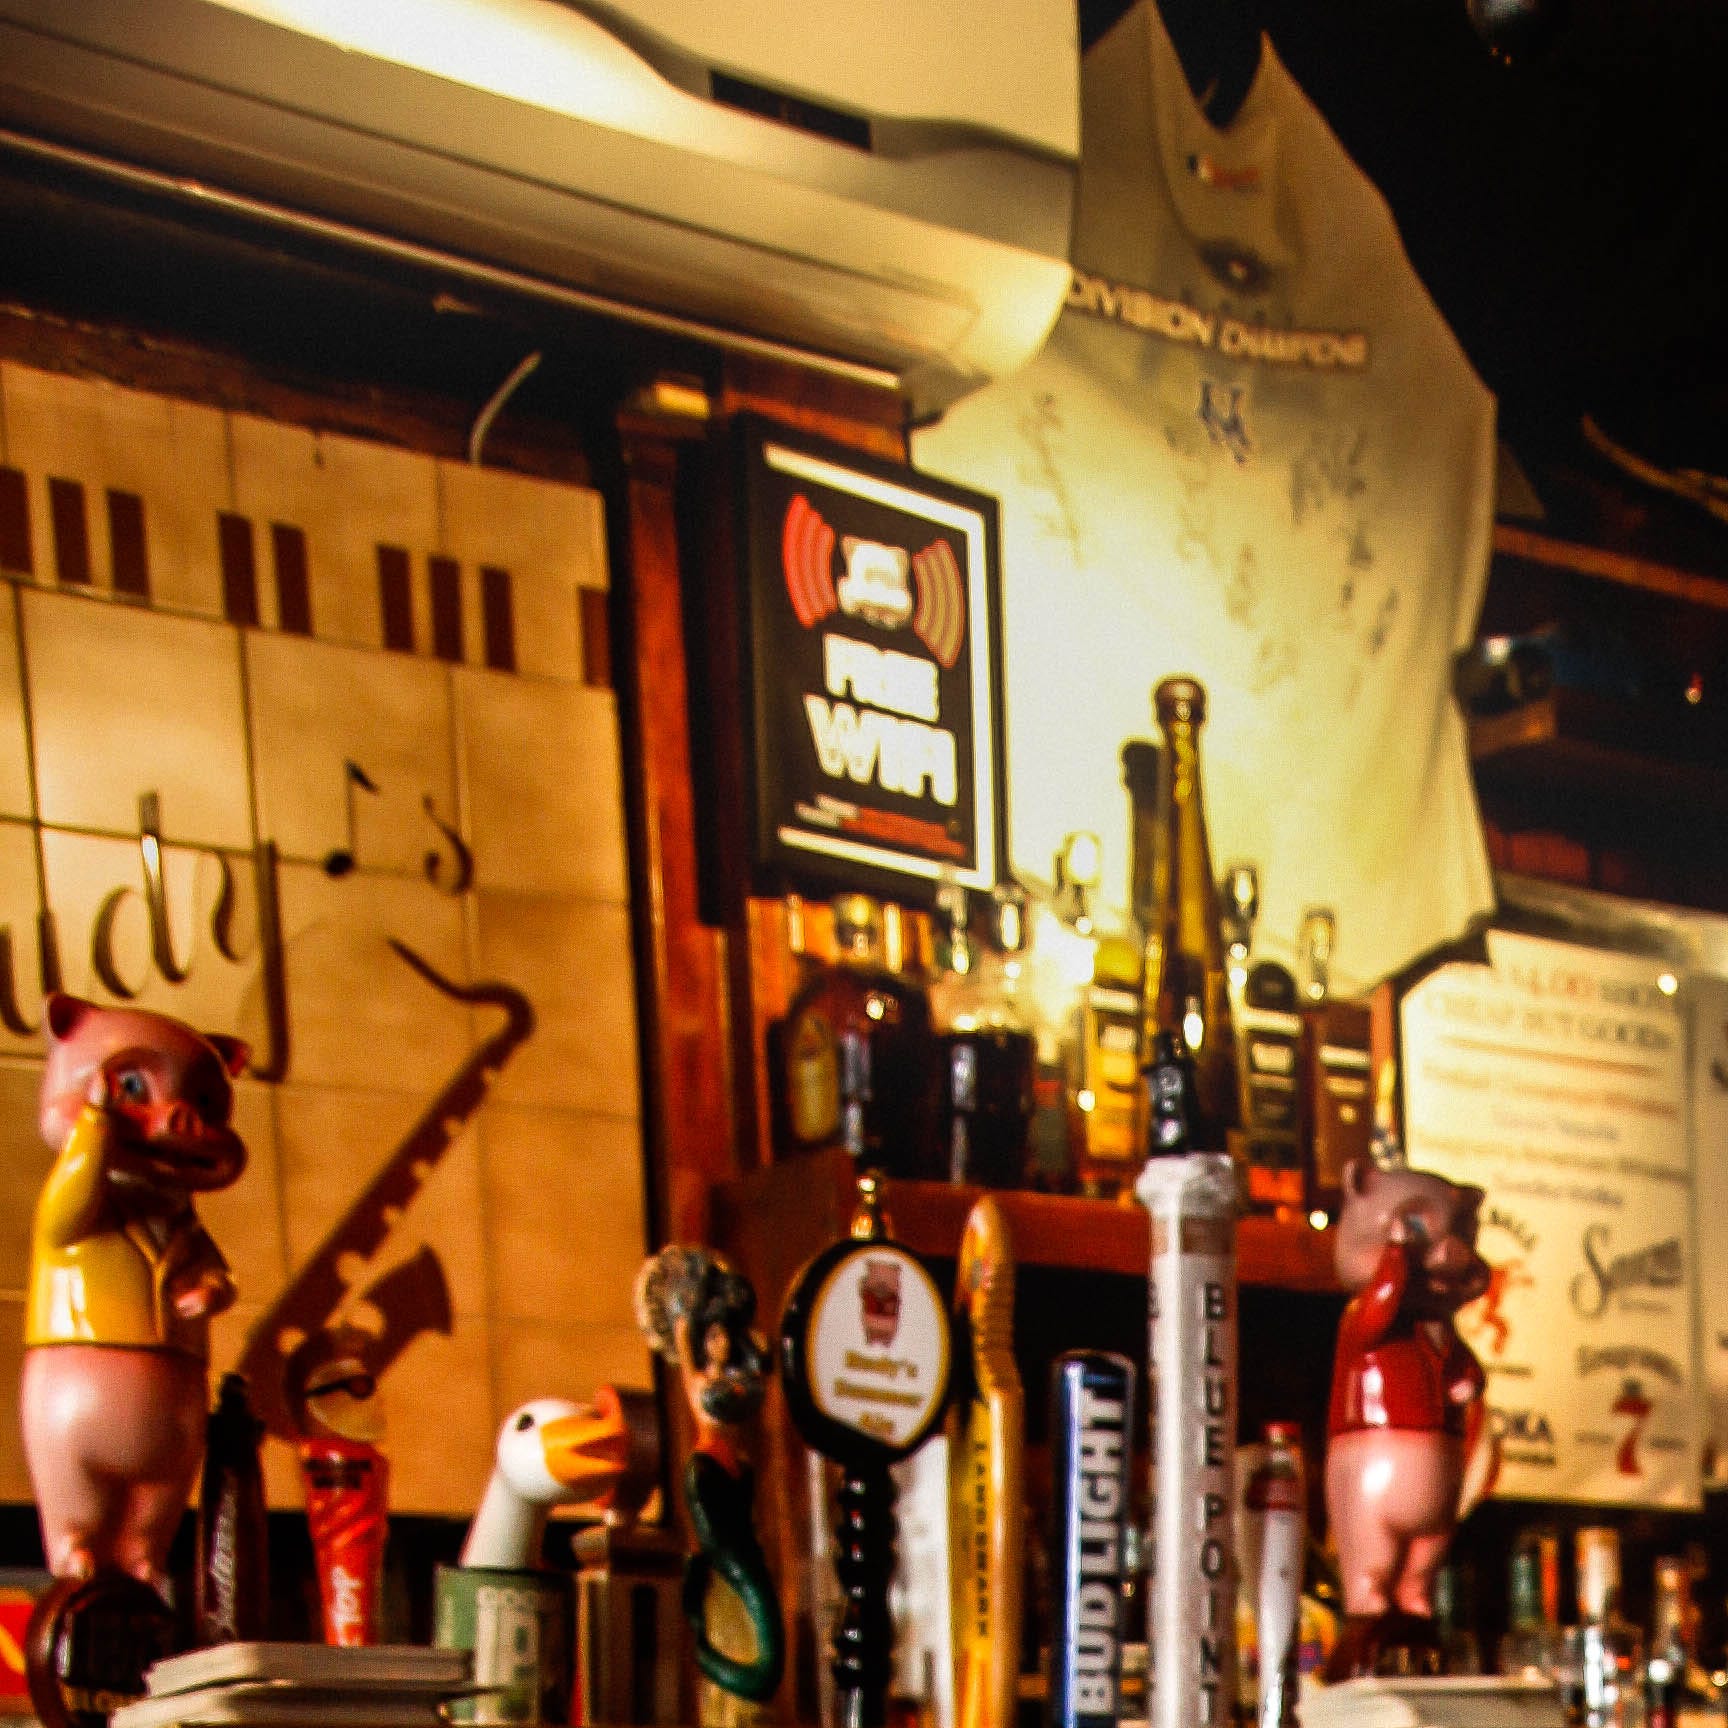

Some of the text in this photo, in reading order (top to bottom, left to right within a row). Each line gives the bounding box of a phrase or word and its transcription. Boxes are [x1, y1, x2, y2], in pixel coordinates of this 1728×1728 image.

[1076, 1384, 1127, 1716] BUD LIGHT
[1199, 1281, 1228, 1728] BLUE POINT
